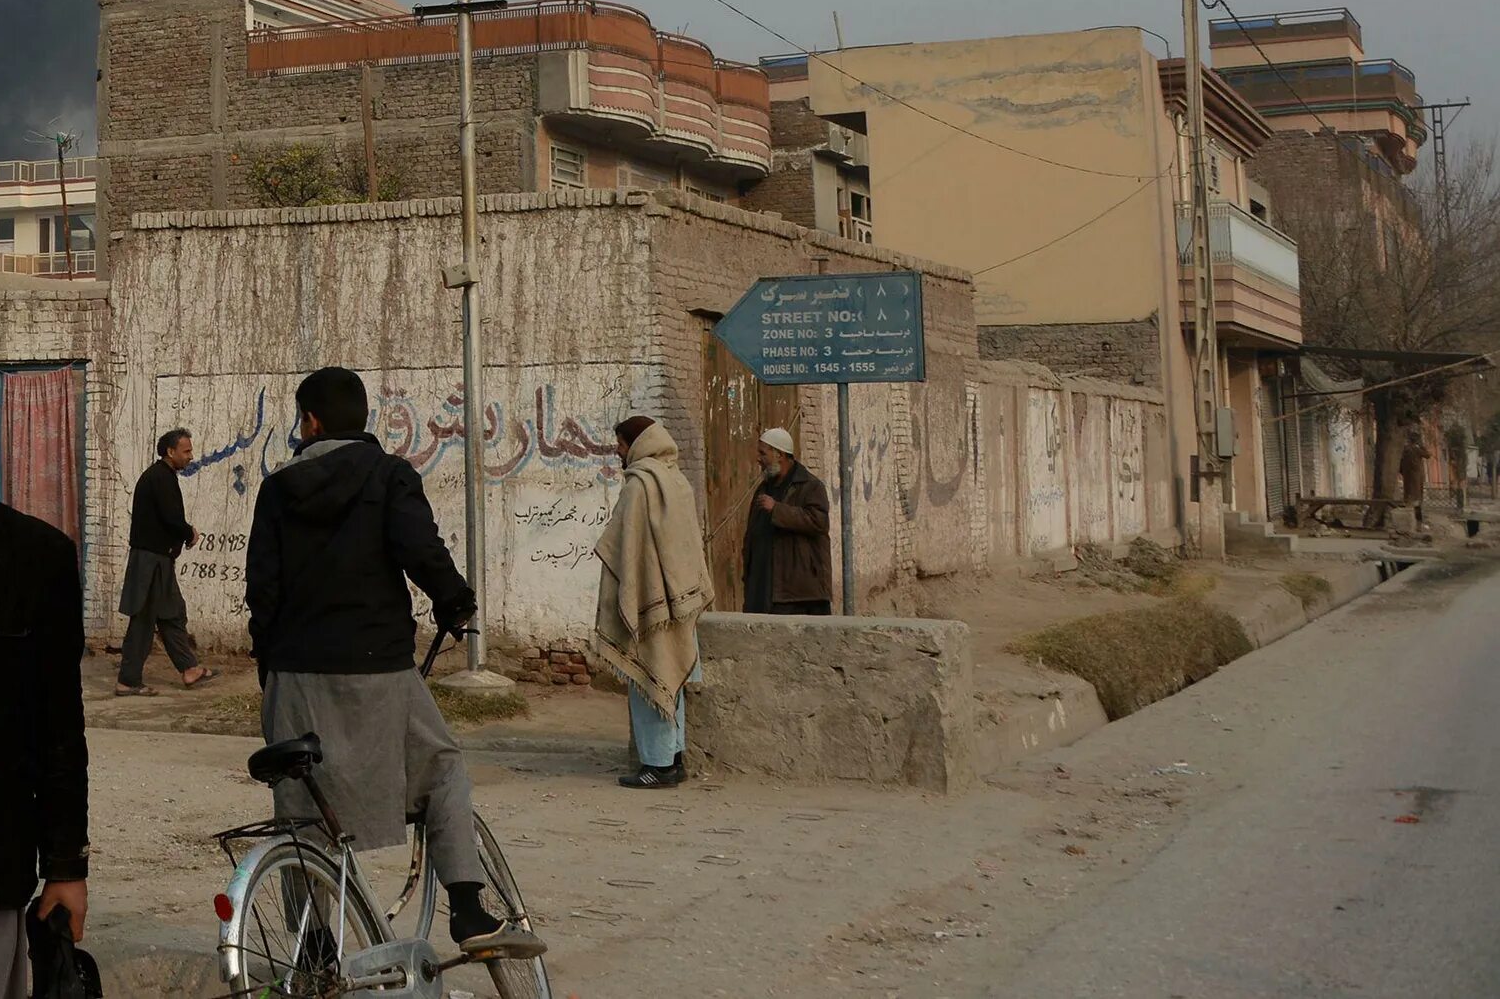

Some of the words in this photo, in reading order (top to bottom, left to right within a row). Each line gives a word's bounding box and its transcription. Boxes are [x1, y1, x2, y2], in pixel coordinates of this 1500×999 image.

[761, 311, 823, 325] STREET
[762, 329, 794, 340] ZONE
[797, 328, 819, 339] NO:
[824, 327, 834, 339] 3
[762, 346, 797, 358] PHASE
[799, 346, 819, 357] NO:
[823, 345, 833, 357] 3
[763, 363, 792, 376] HOUSE
[792, 362, 810, 375] NO:
[814, 362, 840, 374] 1545
[848, 362, 876, 373] 1555
